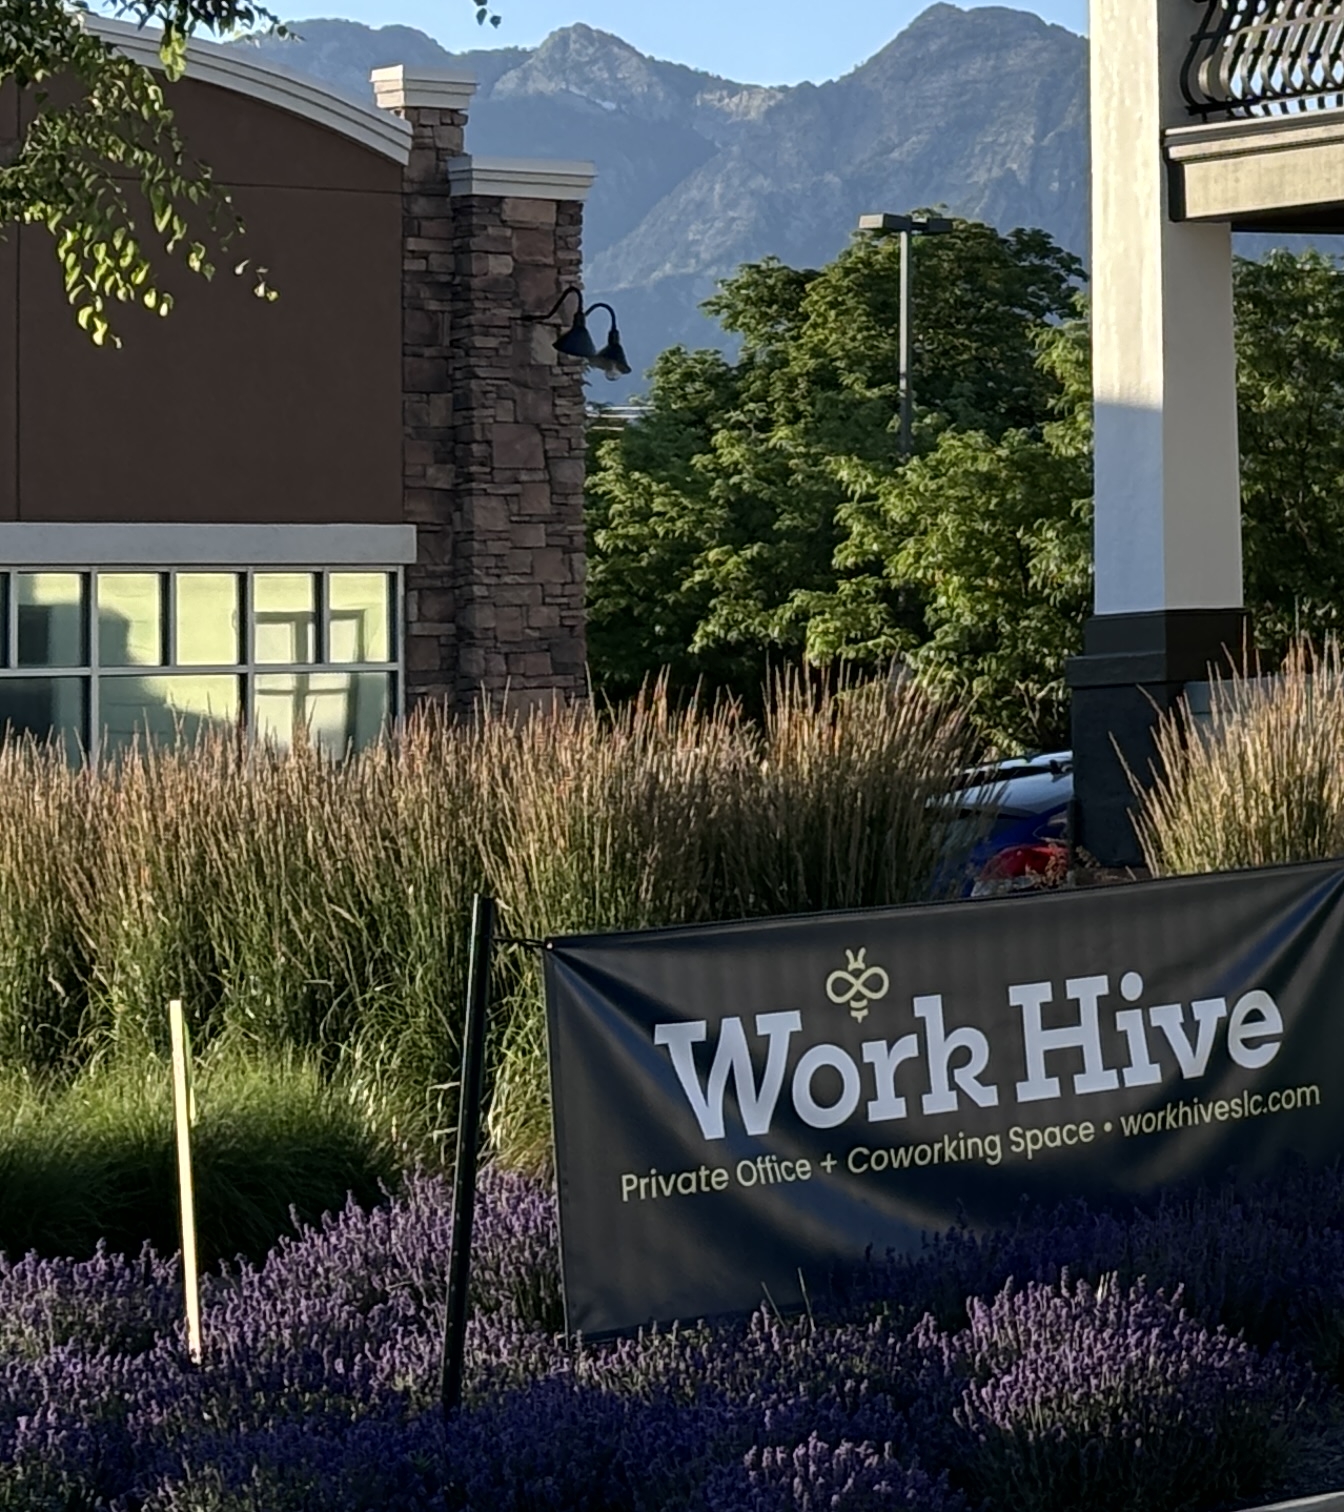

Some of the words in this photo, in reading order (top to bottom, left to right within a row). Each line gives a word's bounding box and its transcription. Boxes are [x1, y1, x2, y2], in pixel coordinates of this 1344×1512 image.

[654, 994, 998, 1140] Work
[1008, 971, 1285, 1103] Hive
[621, 1166, 729, 1202] Private
[736, 1155, 812, 1187] Office
[820, 1152, 837, 1174] +
[848, 1132, 1001, 1174] Coworking
[1010, 1121, 1095, 1159] Space
[1120, 1085, 1321, 1137] workhiveslc.com
